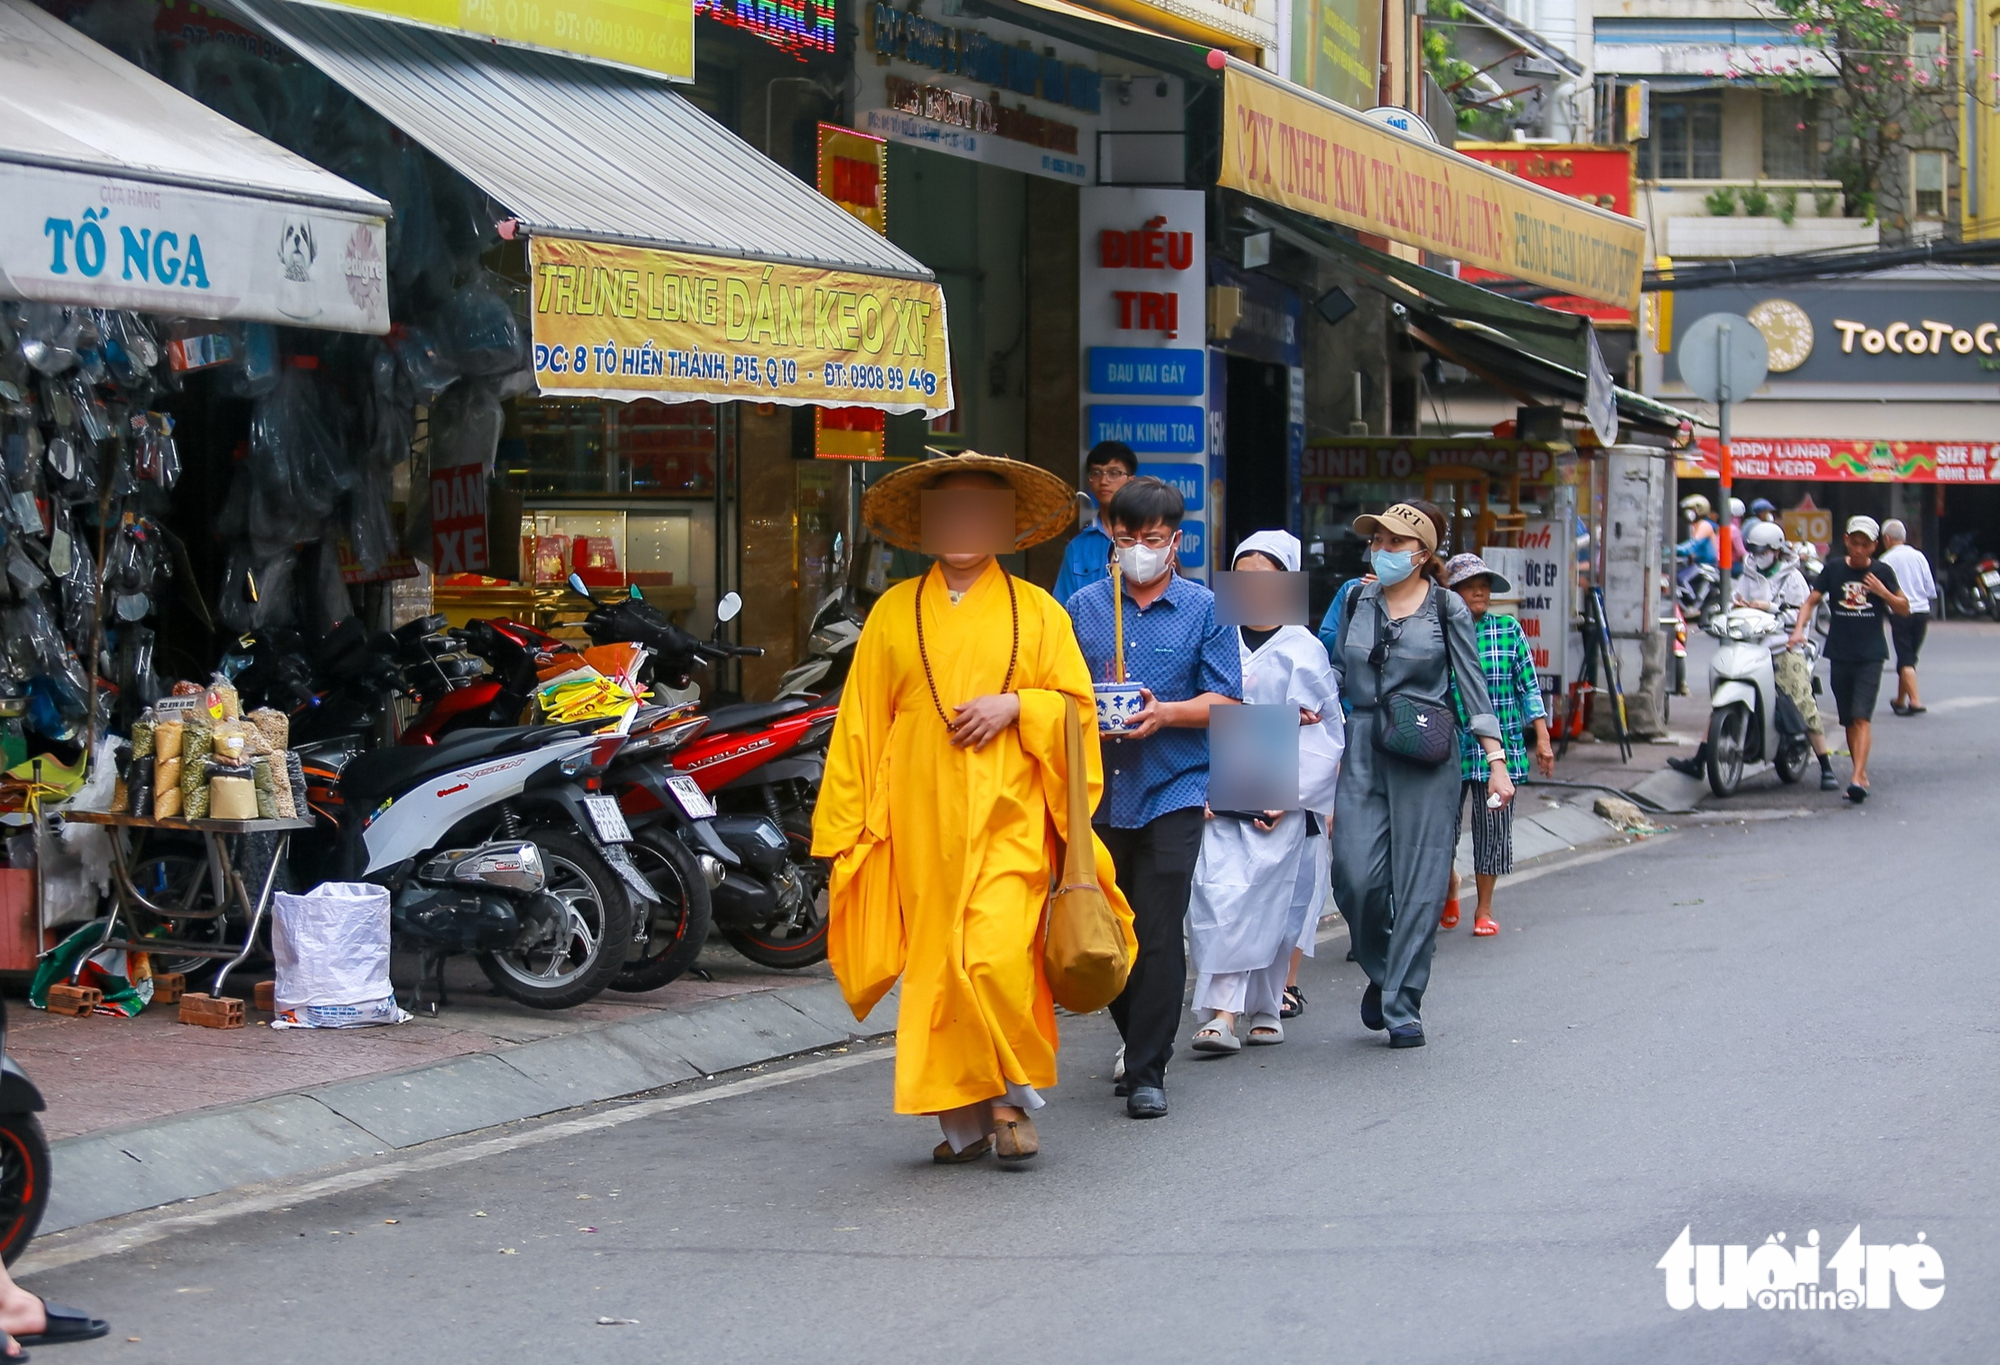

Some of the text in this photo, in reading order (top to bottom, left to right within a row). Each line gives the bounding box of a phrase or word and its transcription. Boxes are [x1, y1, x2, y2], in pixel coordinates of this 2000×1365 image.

[523, 4, 540, 31] 10
[553, 10, 580, 41] ĐT:
[585, 20, 622, 49] 0908
[627, 26, 643, 54] 99
[651, 31, 666, 59] 46
[671, 35, 688, 64] 48
[126, 186, 161, 210] HÀNG
[1238, 104, 1502, 262] CTY TNHH KIM THÀNH HÒA HƯNG
[44, 207, 211, 289] TỐ NGA
[538, 262, 931, 360] TRUNG LONG DÁN KEO XE
[1114, 291, 1179, 340] TRỊ
[535, 343, 570, 374] ĐC:
[573, 345, 588, 373] 8
[594, 338, 617, 374] TÔ
[621, 338, 663, 378] HIẾN
[668, 345, 730, 386] THÀNH,
[733, 355, 762, 386] P15,
[765, 358, 779, 389] Q
[781, 358, 798, 385] 10
[824, 361, 848, 388] ĐT:
[850, 363, 885, 390] 0908
[887, 366, 904, 392] 99
[1108, 360, 1186, 384] ĐAU VAI GÁY
[1137, 423, 1168, 442] KINH
[1172, 423, 1196, 447] TOẠ
[1731, 442, 1831, 459] APPY LUNAR
[1302, 449, 1368, 477] SINH
[1376, 441, 1412, 477] TỐ
[1734, 459, 1816, 476] NEW YEAR
[1935, 445, 1969, 465] SIZE
[431, 466, 486, 574] DÁN XE
[1524, 559, 1558, 588] ỚC ÉP
